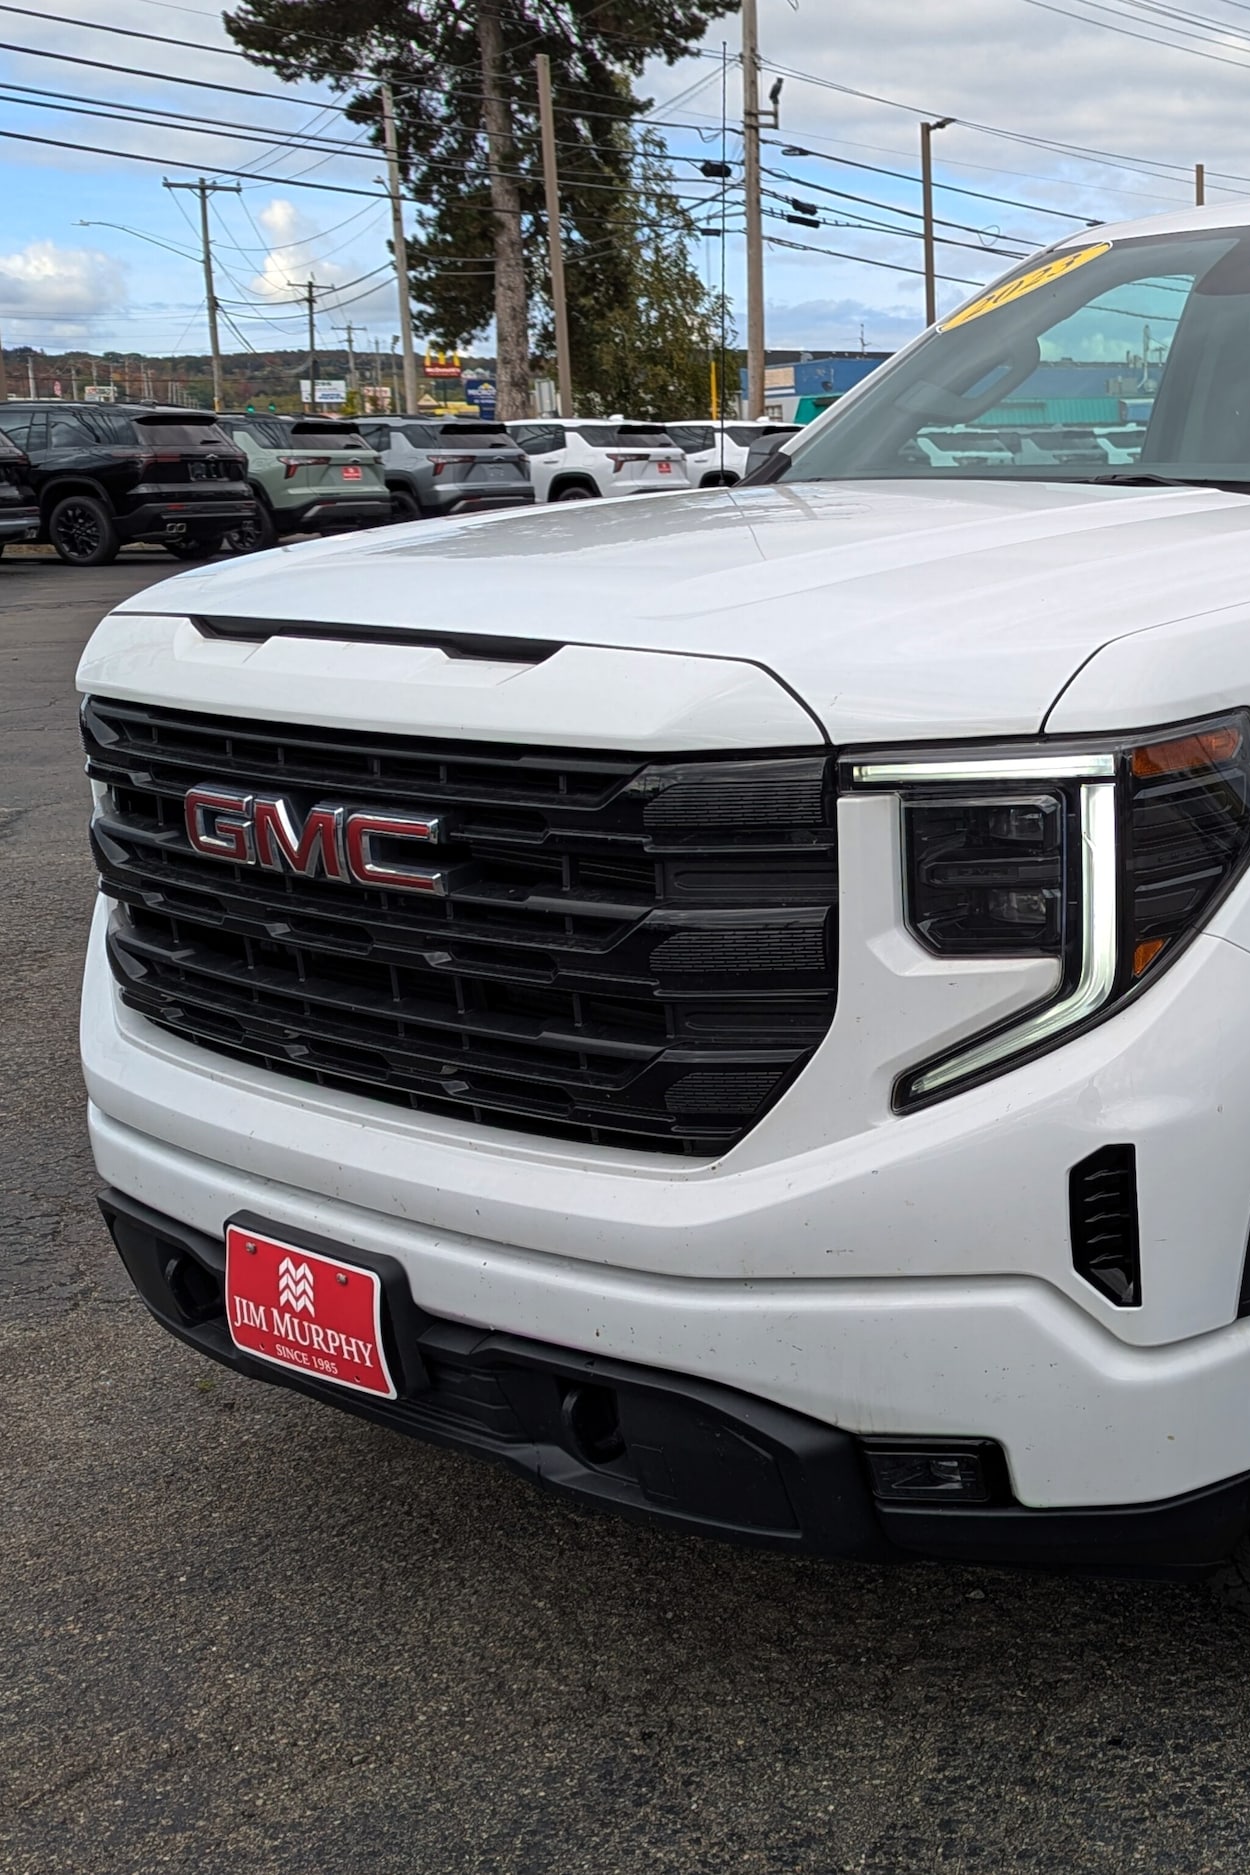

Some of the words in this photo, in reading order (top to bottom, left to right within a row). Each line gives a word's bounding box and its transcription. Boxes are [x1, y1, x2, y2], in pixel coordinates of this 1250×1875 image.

[184, 785, 447, 896] GMC
[233, 1295, 269, 1332] JIM
[271, 1307, 373, 1368] MURPHY
[275, 1343, 310, 1366] SINCE
[312, 1356, 338, 1375] 1985
